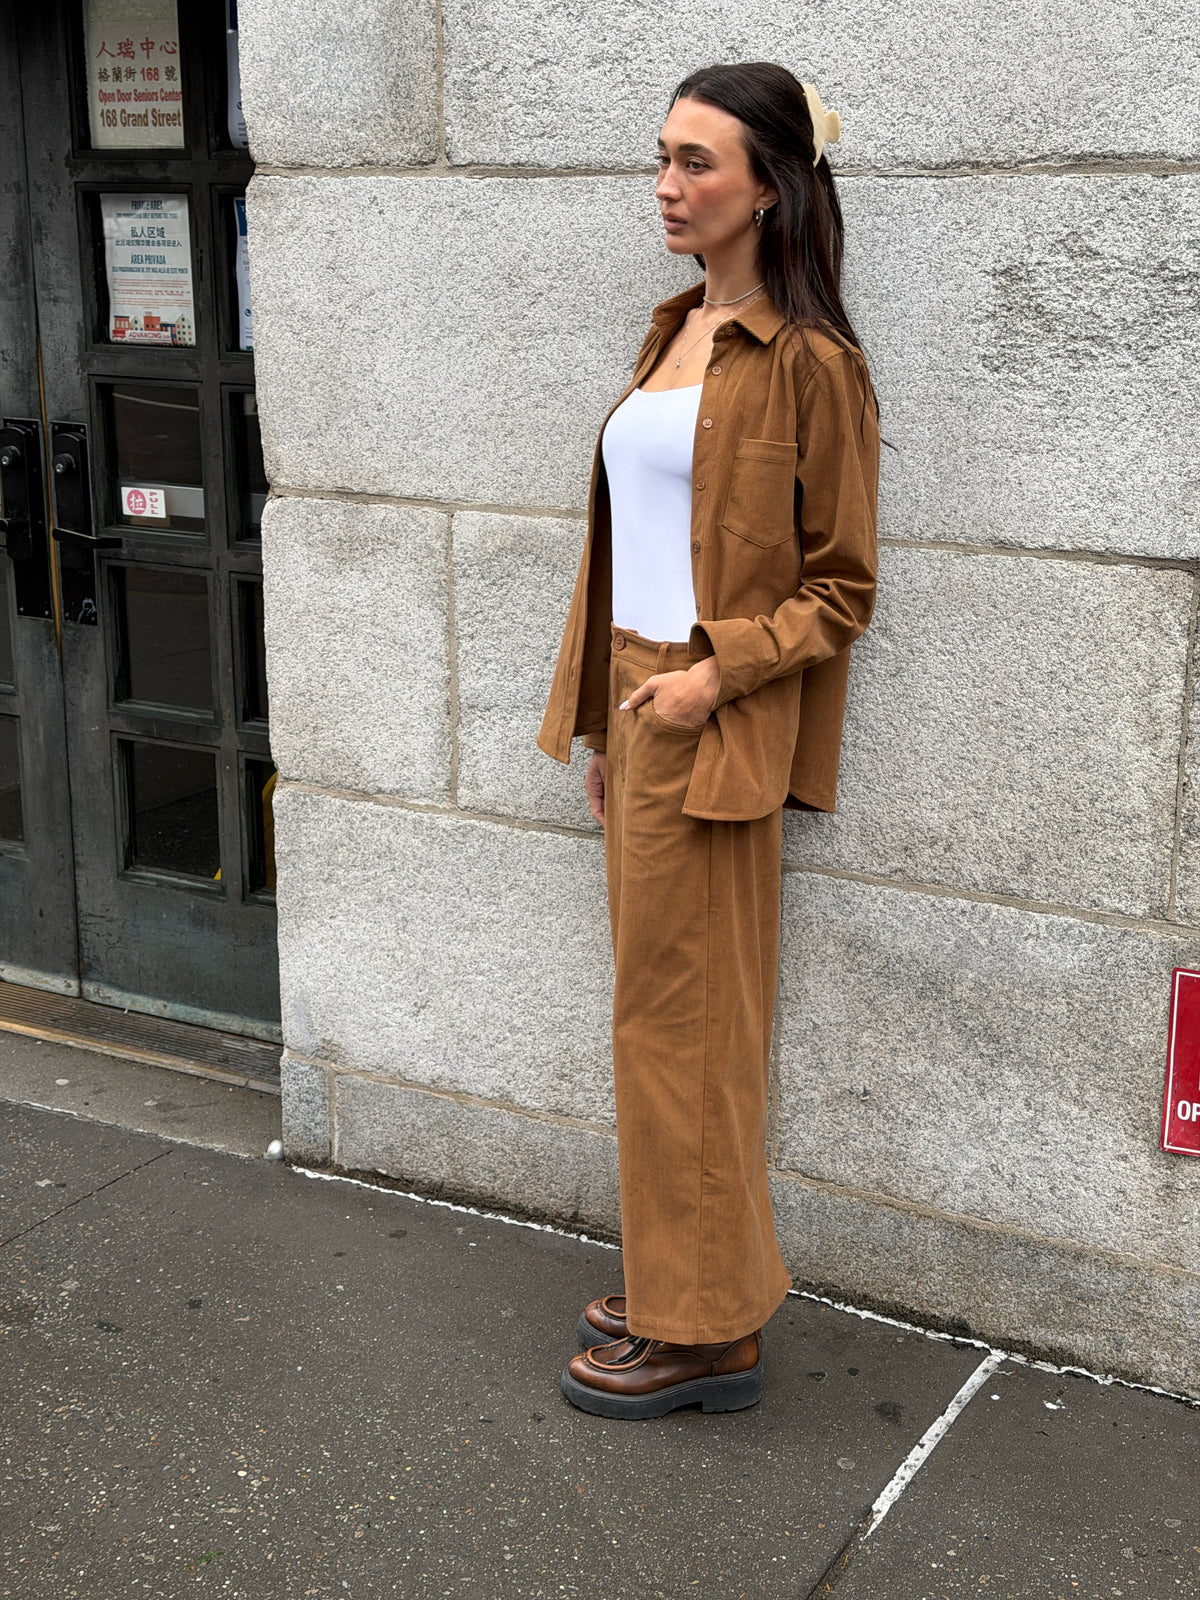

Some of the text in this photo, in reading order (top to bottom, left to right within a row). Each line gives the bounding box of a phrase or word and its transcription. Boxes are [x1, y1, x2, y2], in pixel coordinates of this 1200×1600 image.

[96, 37, 178, 60] 人瑞中心
[140, 67, 160, 81] 168
[98, 87, 182, 105] Open Door Seniors Center
[100, 108, 182, 127] 168 Grand Street
[130, 226, 166, 238] 私人区域
[144, 254, 167, 265] PRIVADA
[129, 493, 146, 511] 拉
